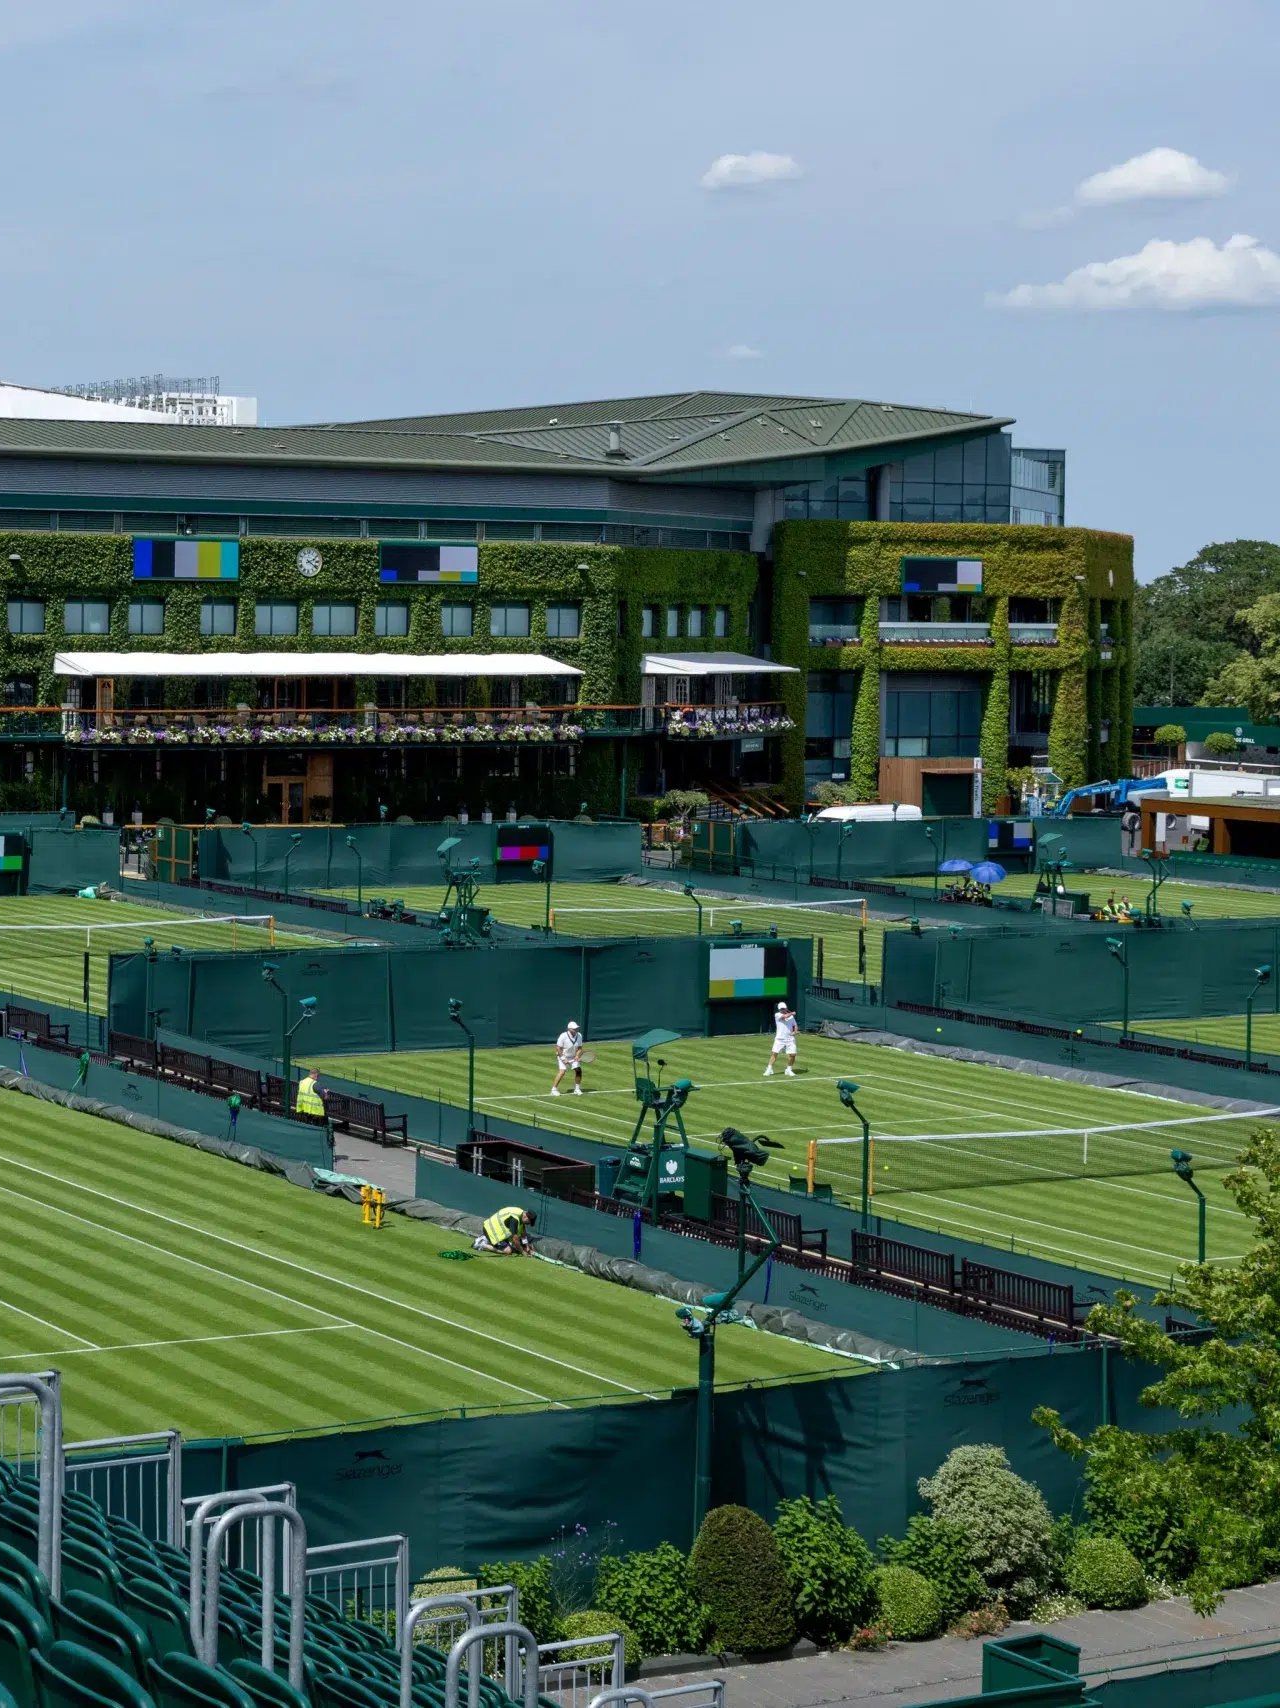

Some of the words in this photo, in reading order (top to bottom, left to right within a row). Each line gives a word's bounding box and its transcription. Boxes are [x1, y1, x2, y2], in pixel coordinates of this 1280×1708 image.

[788, 1291, 828, 1312] Slazenger
[944, 1392, 1003, 1407] Slazenger
[335, 1463, 403, 1481] Slazenger
